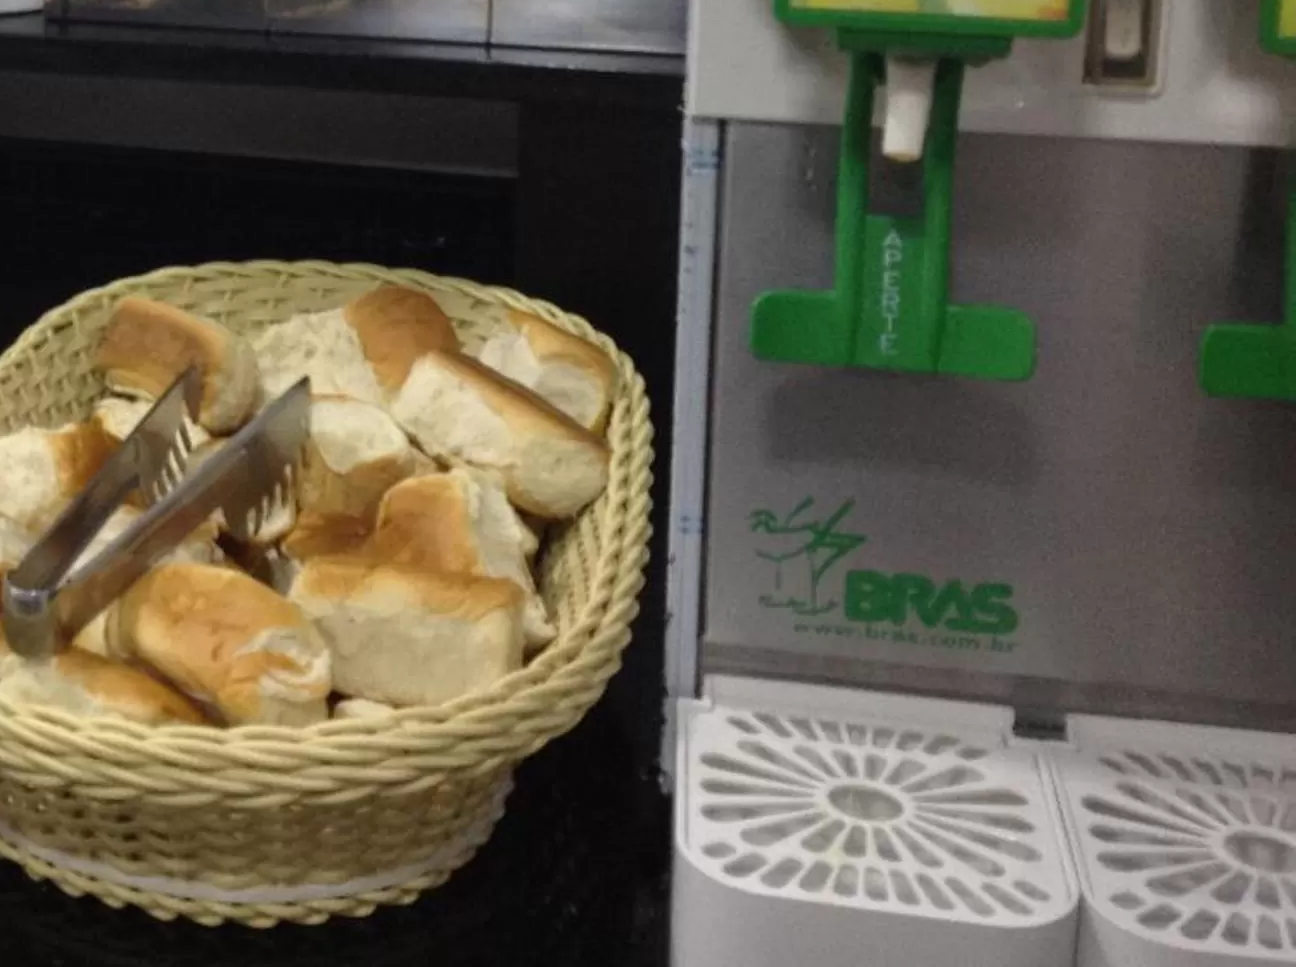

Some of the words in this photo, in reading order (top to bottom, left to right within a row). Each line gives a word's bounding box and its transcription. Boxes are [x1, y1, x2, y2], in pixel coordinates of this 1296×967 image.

[879, 228, 903, 355] APERTE
[844, 569, 1019, 635] BRAS
[793, 622, 1017, 652] www.bras.com.br
